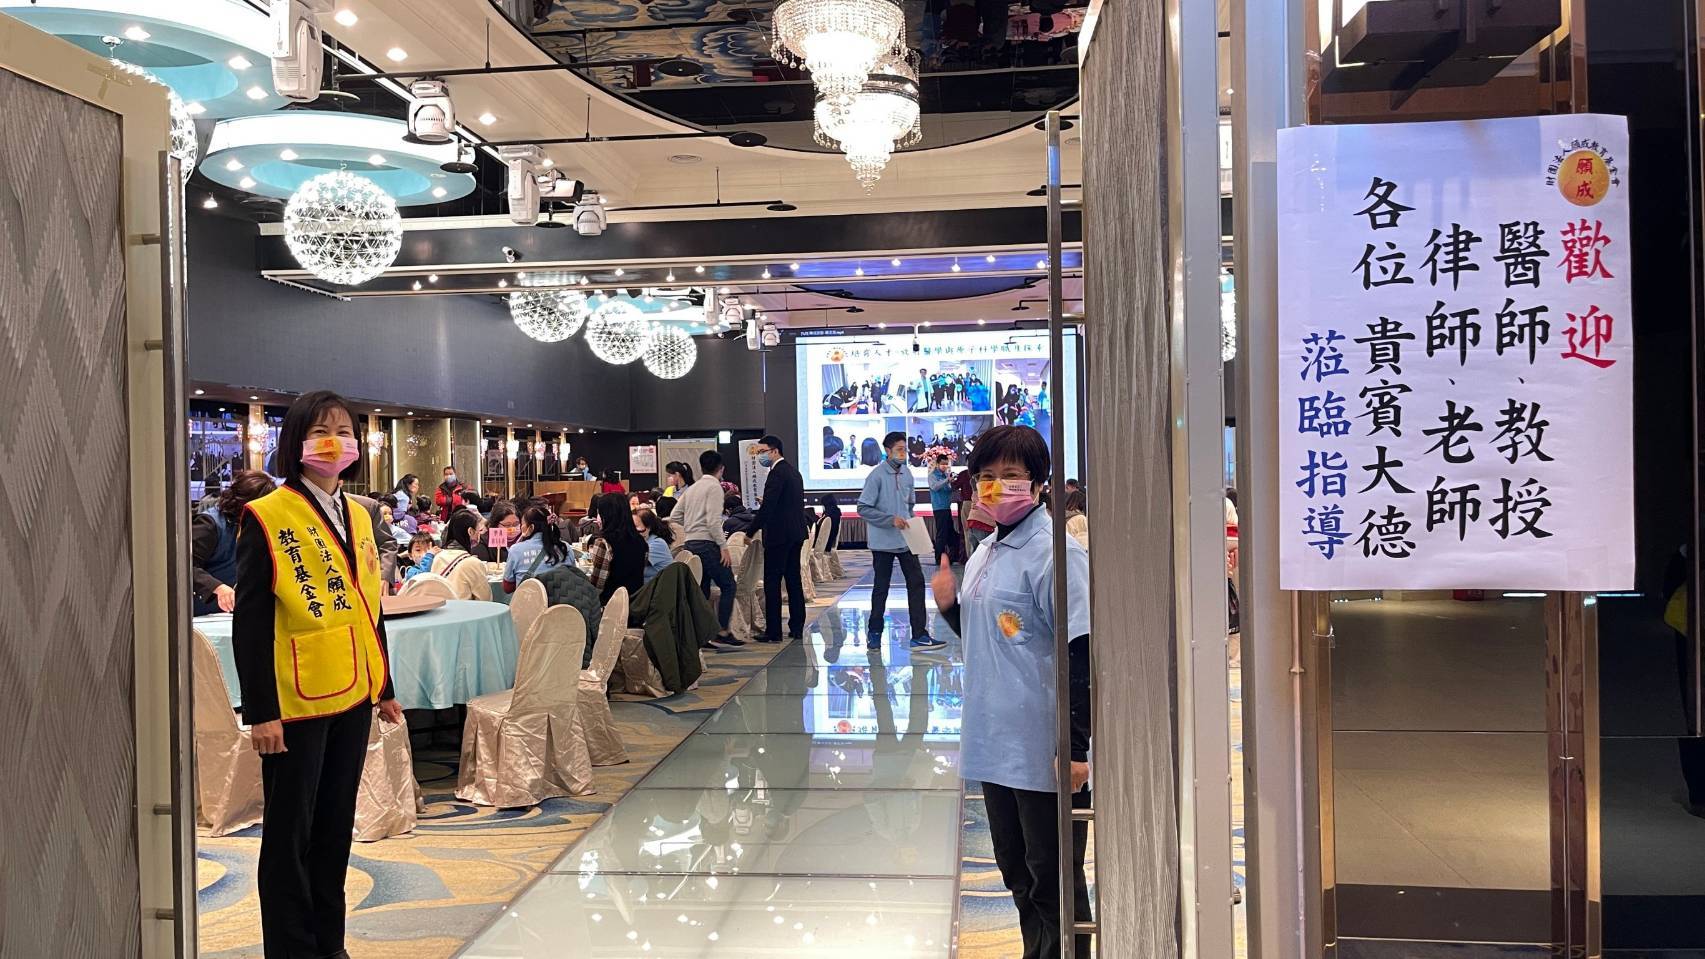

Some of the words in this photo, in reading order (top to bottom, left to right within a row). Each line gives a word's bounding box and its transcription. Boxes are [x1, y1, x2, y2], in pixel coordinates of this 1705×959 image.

[1576, 158, 1594, 199] 願成
[1556, 219, 1618, 369] 歡迎
[1295, 329, 1352, 560] 蒞臨指導
[1420, 223, 1483, 541] 律師、老師
[1488, 220, 1555, 540] 醫師、教授
[278, 528, 325, 618] 教育基金會
[306, 526, 352, 612] 財團法人願成
